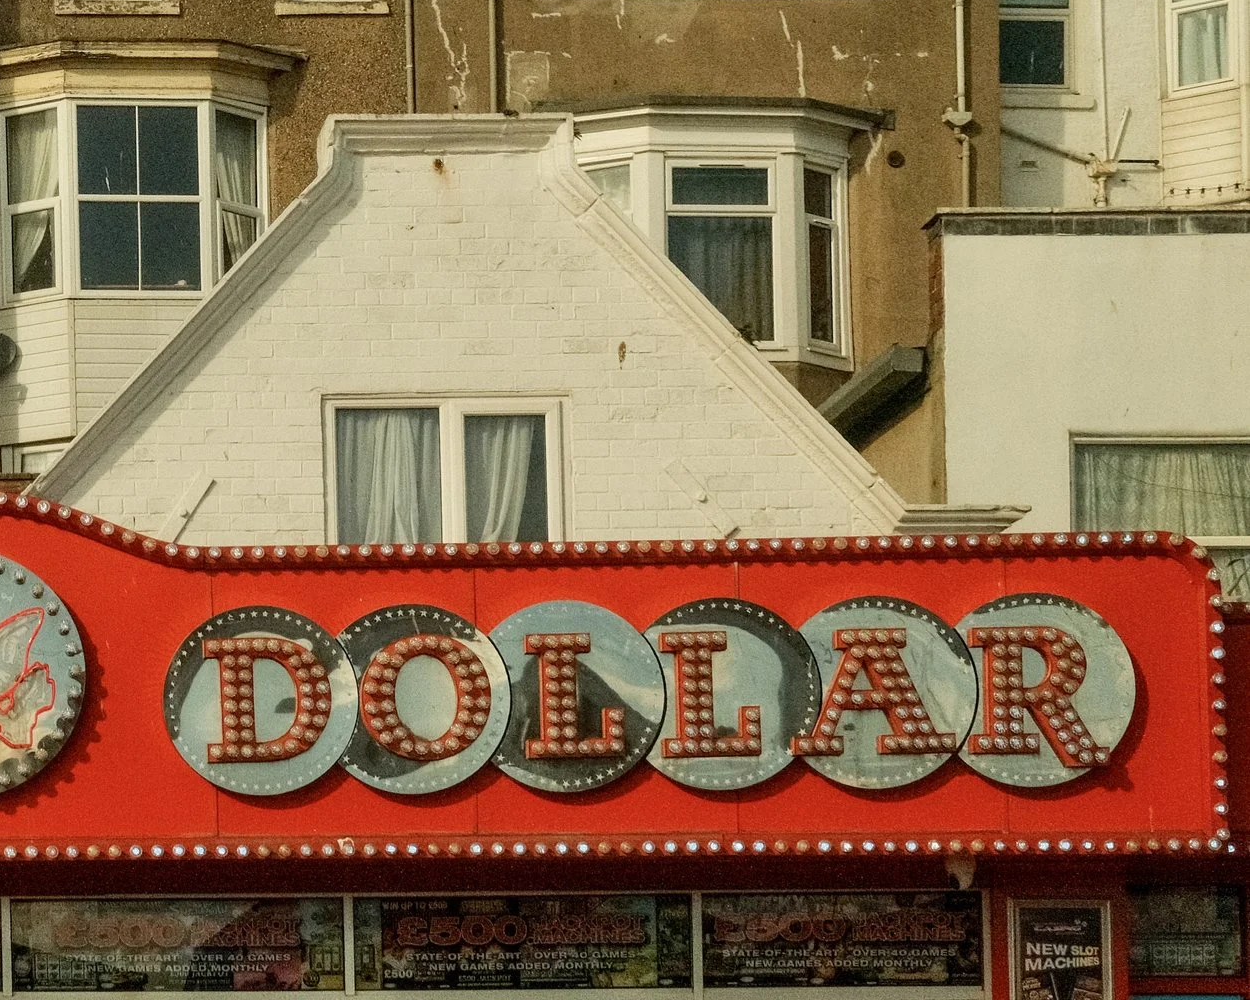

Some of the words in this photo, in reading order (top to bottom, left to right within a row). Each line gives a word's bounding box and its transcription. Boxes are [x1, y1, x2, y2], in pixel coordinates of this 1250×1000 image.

[203, 626, 1110, 768] DOLLAR
[396, 914, 529, 947] £500
[852, 926, 966, 942] MACHINES
[534, 930, 645, 944] MACHINES
[853, 949, 886, 957] OVER
[890, 949, 907, 957] 40
[911, 949, 956, 957] GAMES
[1025, 942, 1067, 956] NEW
[1070, 945, 1099, 956] SLOT
[190, 954, 223, 962] OVER
[227, 954, 245, 962] 40
[248, 954, 292, 962] GAMES
[534, 952, 567, 960] OVER
[570, 952, 588, 960] 40
[592, 952, 636, 960] GAMES
[88, 964, 115, 972] NEW
[117, 964, 162, 972] GAMES
[165, 964, 207, 972] ADDED
[211, 964, 269, 972] MONTHLY
[428, 962, 456, 971] NEW
[460, 962, 505, 971] GAMES
[508, 962, 550, 971] ADDED
[555, 962, 614, 971] MONTHLY
[745, 960, 774, 968] NEW
[778, 960, 822, 968] GAMES
[825, 960, 869, 968] ADDED
[873, 960, 933, 968] MONTHLY
[1024, 956, 1100, 971] MACHINES
[384, 970, 413, 979] £500
